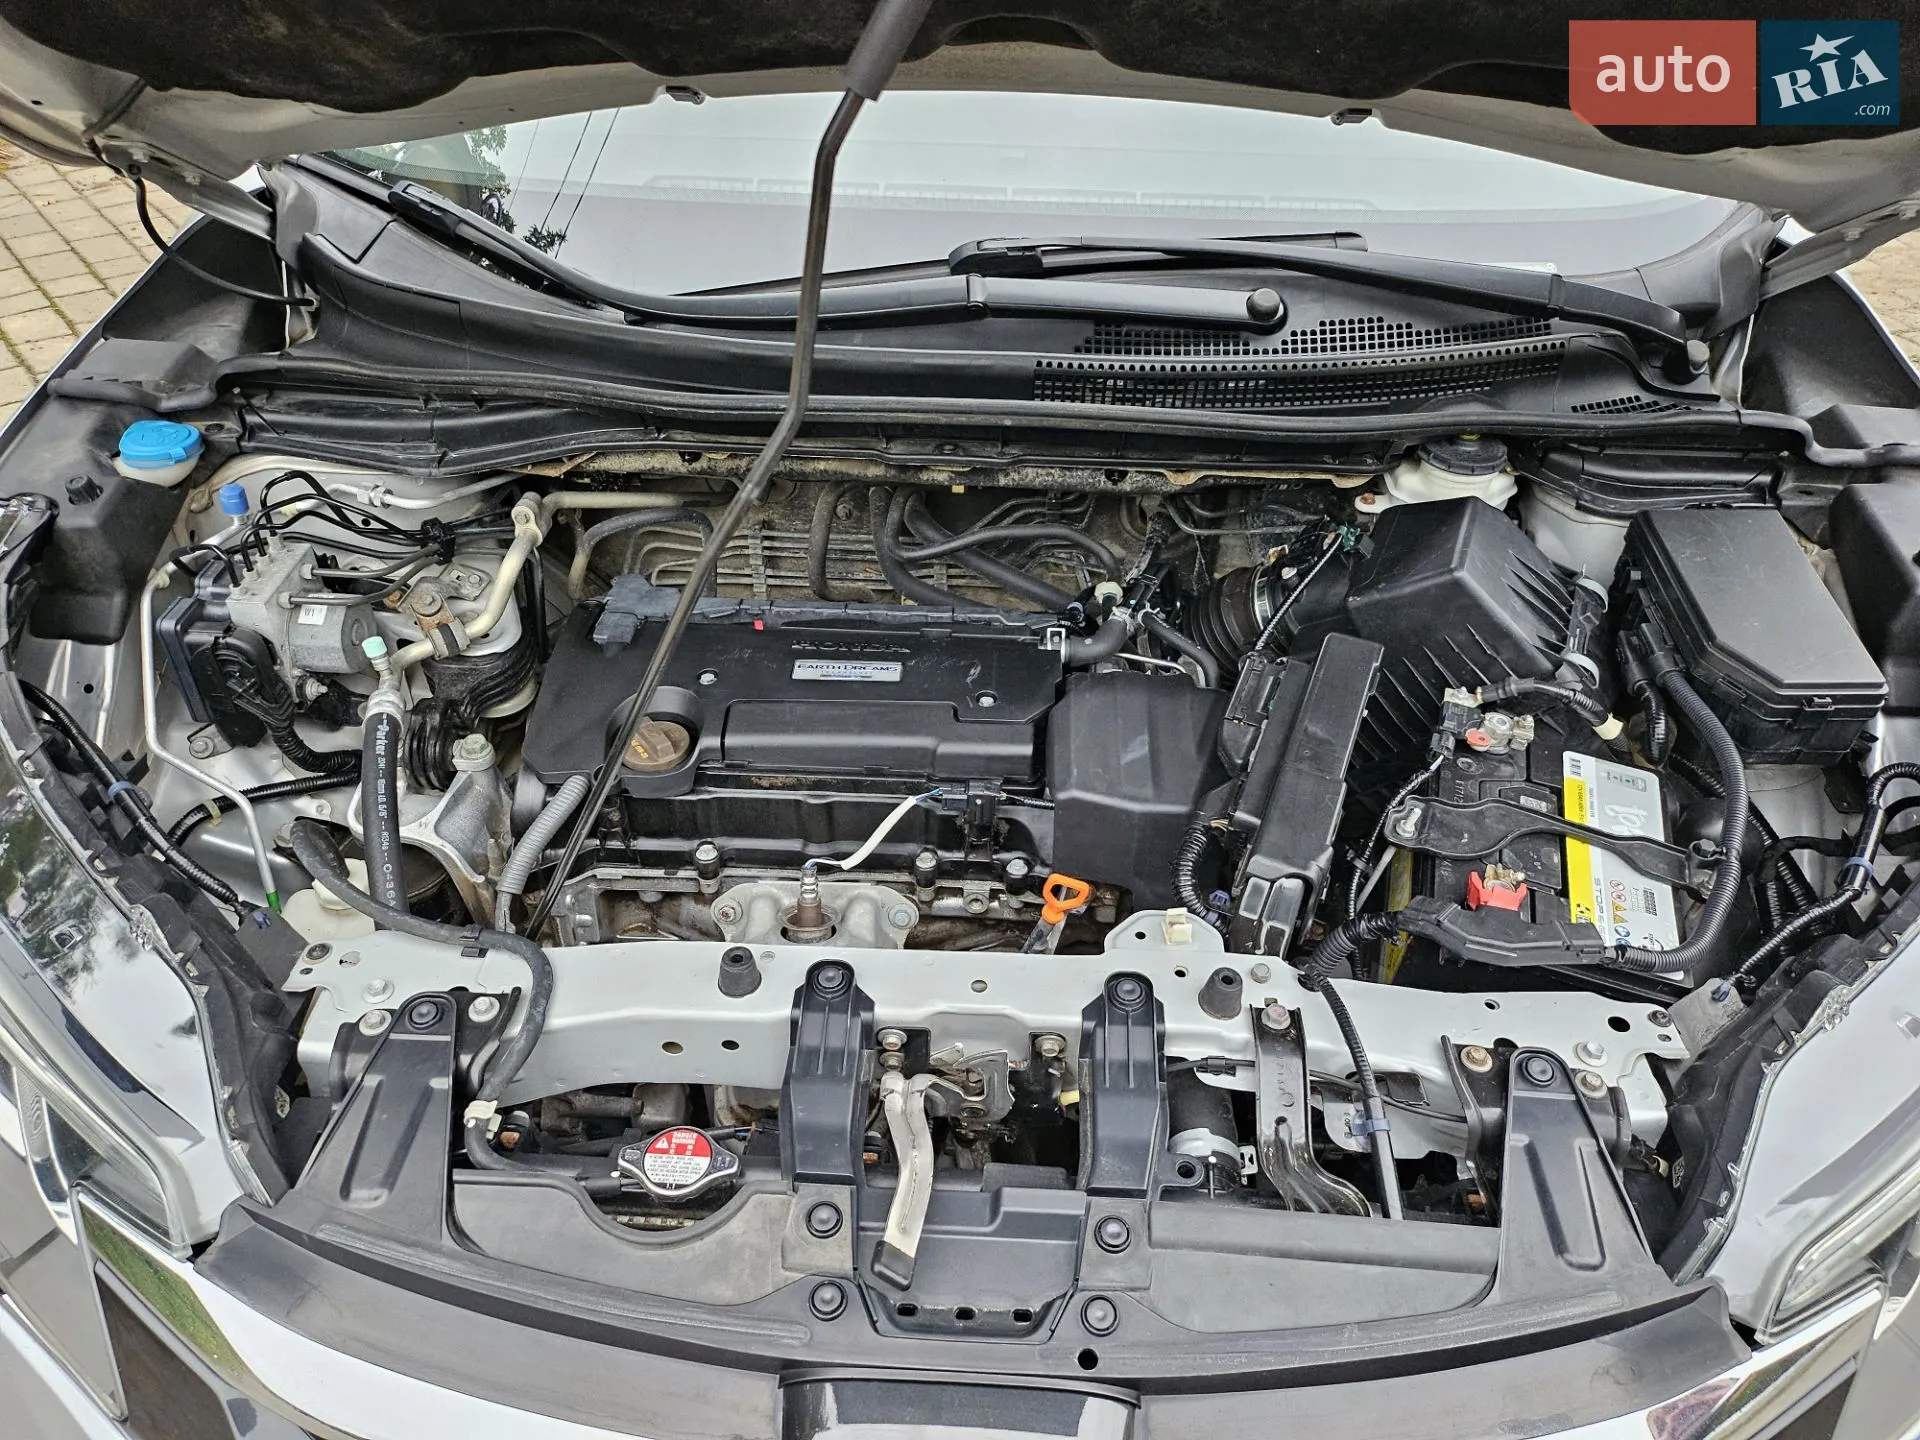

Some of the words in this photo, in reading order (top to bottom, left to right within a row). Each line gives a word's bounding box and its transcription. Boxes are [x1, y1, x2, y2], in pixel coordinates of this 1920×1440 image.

[797, 663, 841, 671] EARTH
[844, 664, 898, 672] DREAMS
[376, 724, 390, 756] Parker
